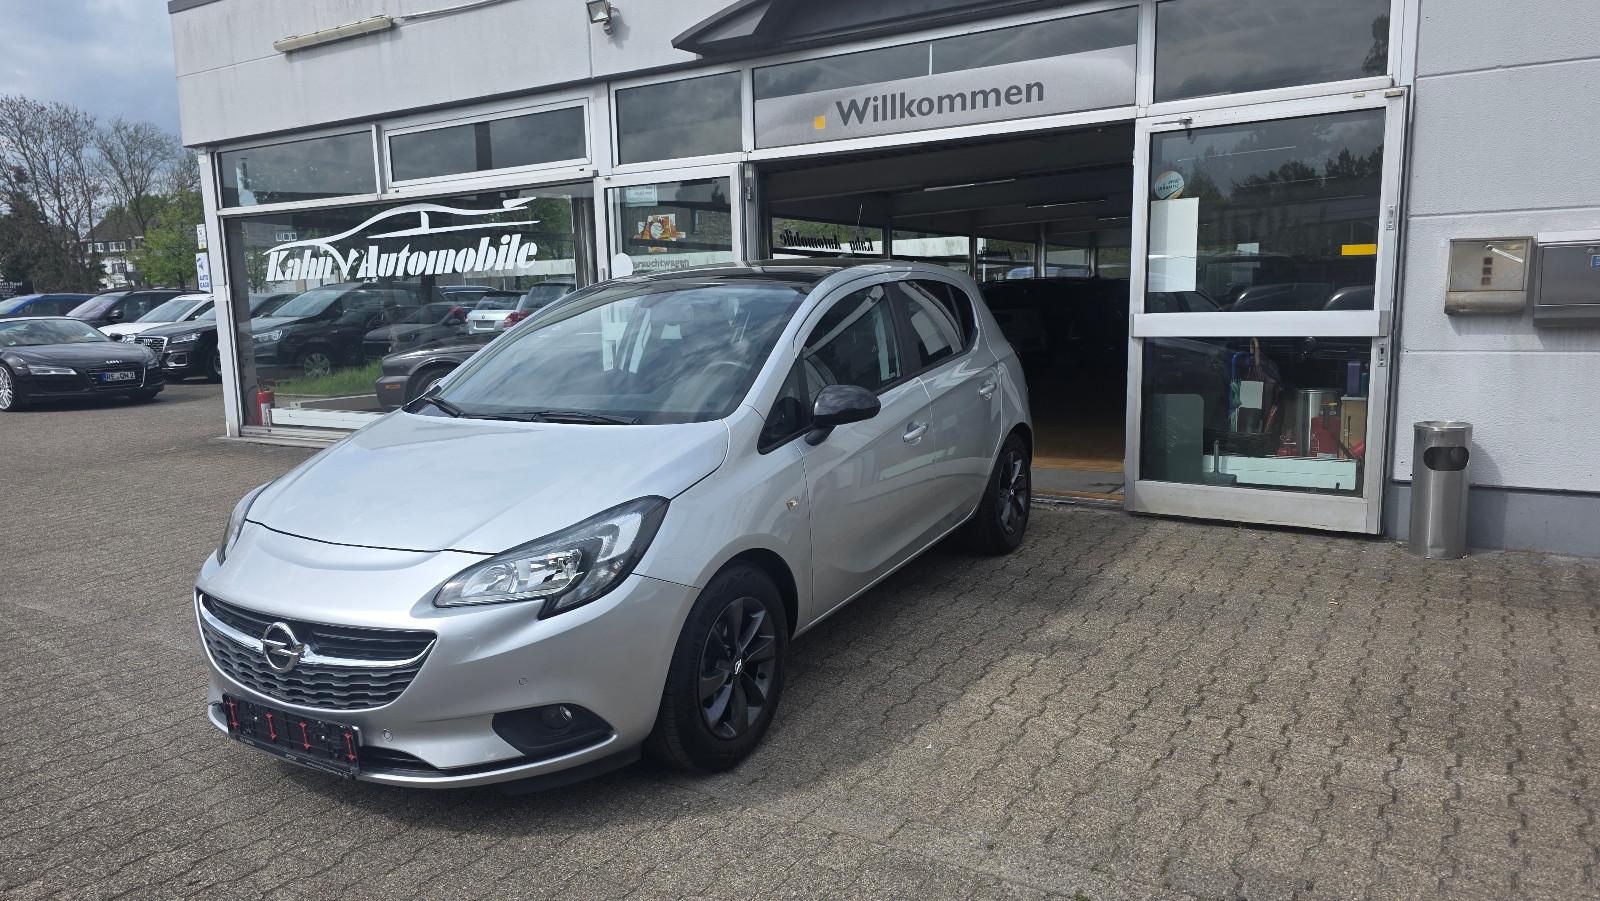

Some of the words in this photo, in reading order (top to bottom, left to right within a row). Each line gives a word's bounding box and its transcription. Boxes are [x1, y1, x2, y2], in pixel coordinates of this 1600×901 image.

[835, 81, 1044, 127] Willkommen
[265, 249, 333, 281] Kahn
[356, 233, 538, 278] Automobile
